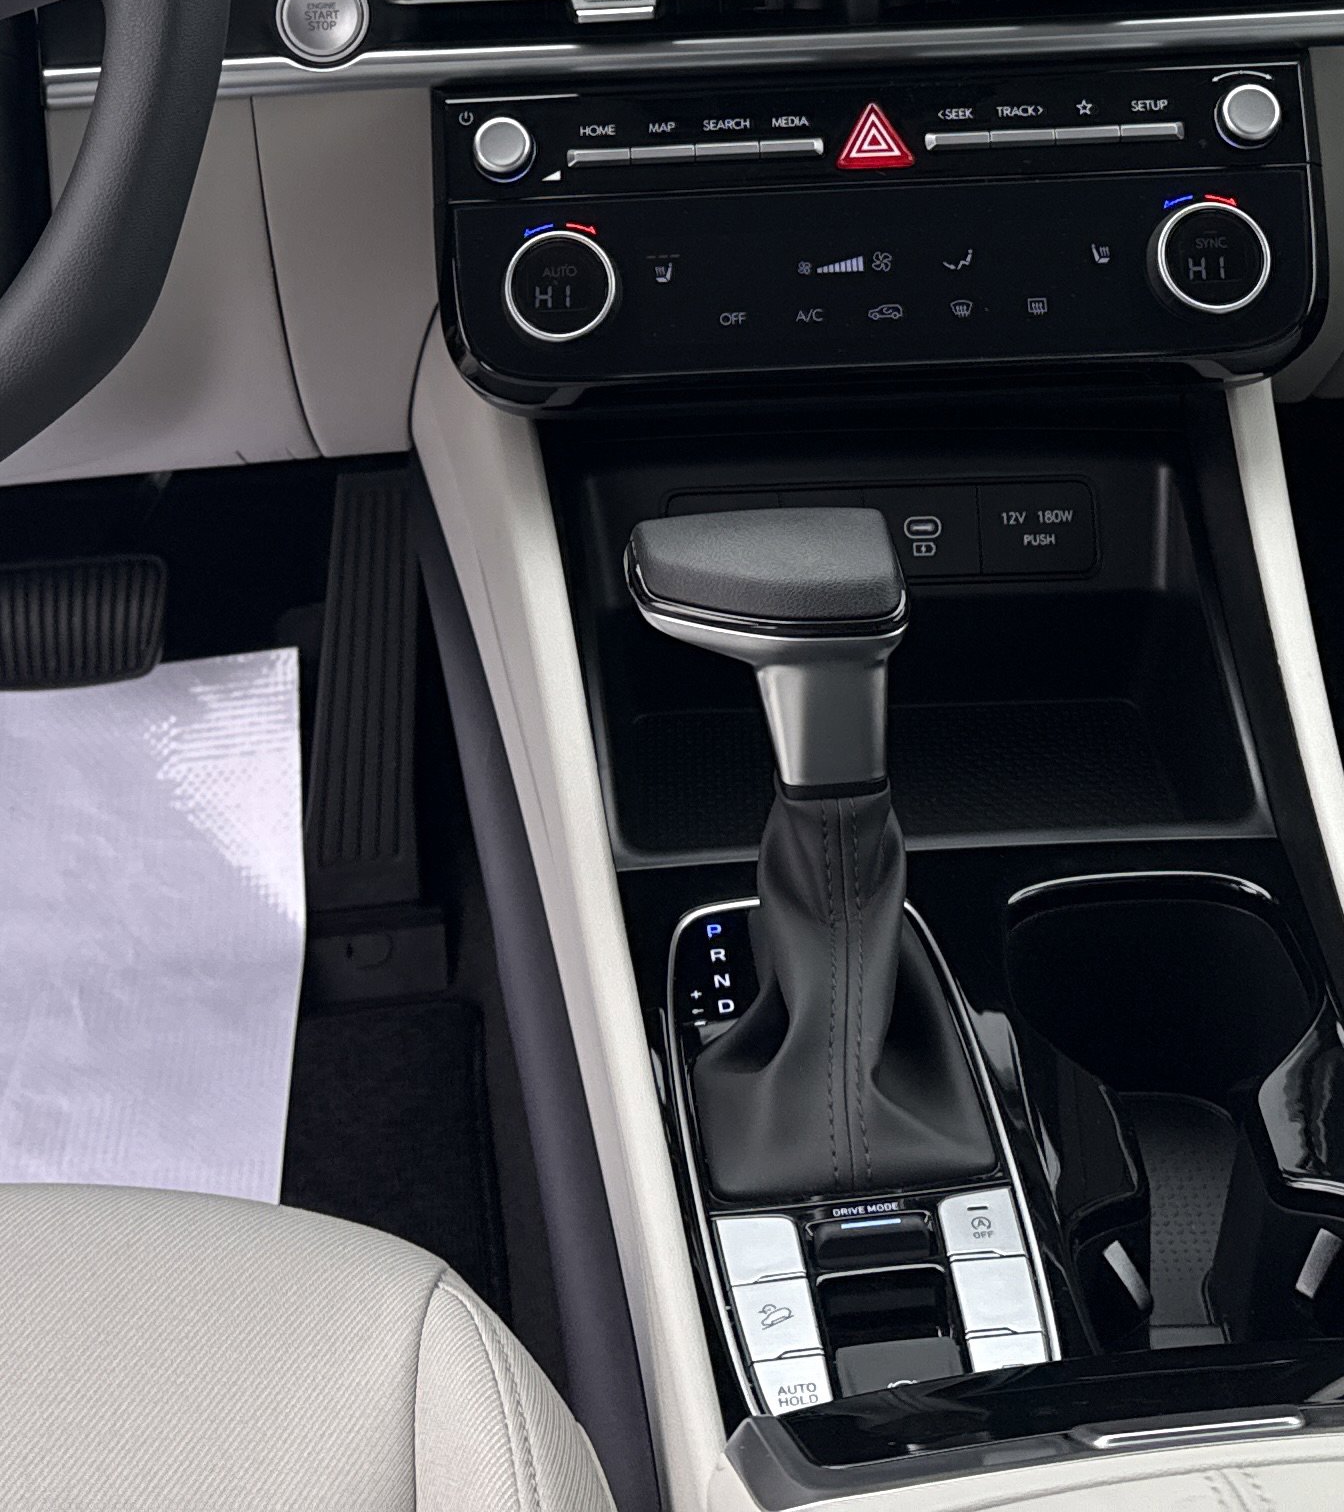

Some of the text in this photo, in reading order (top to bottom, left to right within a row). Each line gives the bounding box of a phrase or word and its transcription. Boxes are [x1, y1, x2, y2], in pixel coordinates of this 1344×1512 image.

[307, 2, 337, 10] ENGINE
[304, 10, 340, 21] START
[308, 21, 337, 31] STOP
[1131, 99, 1168, 112] SETUP
[648, 122, 676, 133] MAP
[703, 118, 751, 131] SEARCH
[772, 116, 809, 128] MEDIA
[579, 125, 616, 136] HOME
[1195, 236, 1228, 249] SYNC
[542, 265, 578, 278] AUTO
[1188, 256, 1225, 281] HI
[535, 285, 571, 308] HI
[719, 311, 748, 326] OFF
[795, 308, 824, 323] A/C
[1001, 510, 1073, 525] 12V 180W
[1023, 533, 1056, 546] PUSH
[706, 924, 722, 939] P
[710, 948, 726, 963] R
[713, 973, 731, 989] N
[717, 999, 735, 1014] D
[832, 1202, 899, 1217] DRIVE MODE
[972, 1230, 994, 1239] OFF
[777, 1382, 817, 1396] AUTO
[778, 1394, 819, 1407] HOLD
